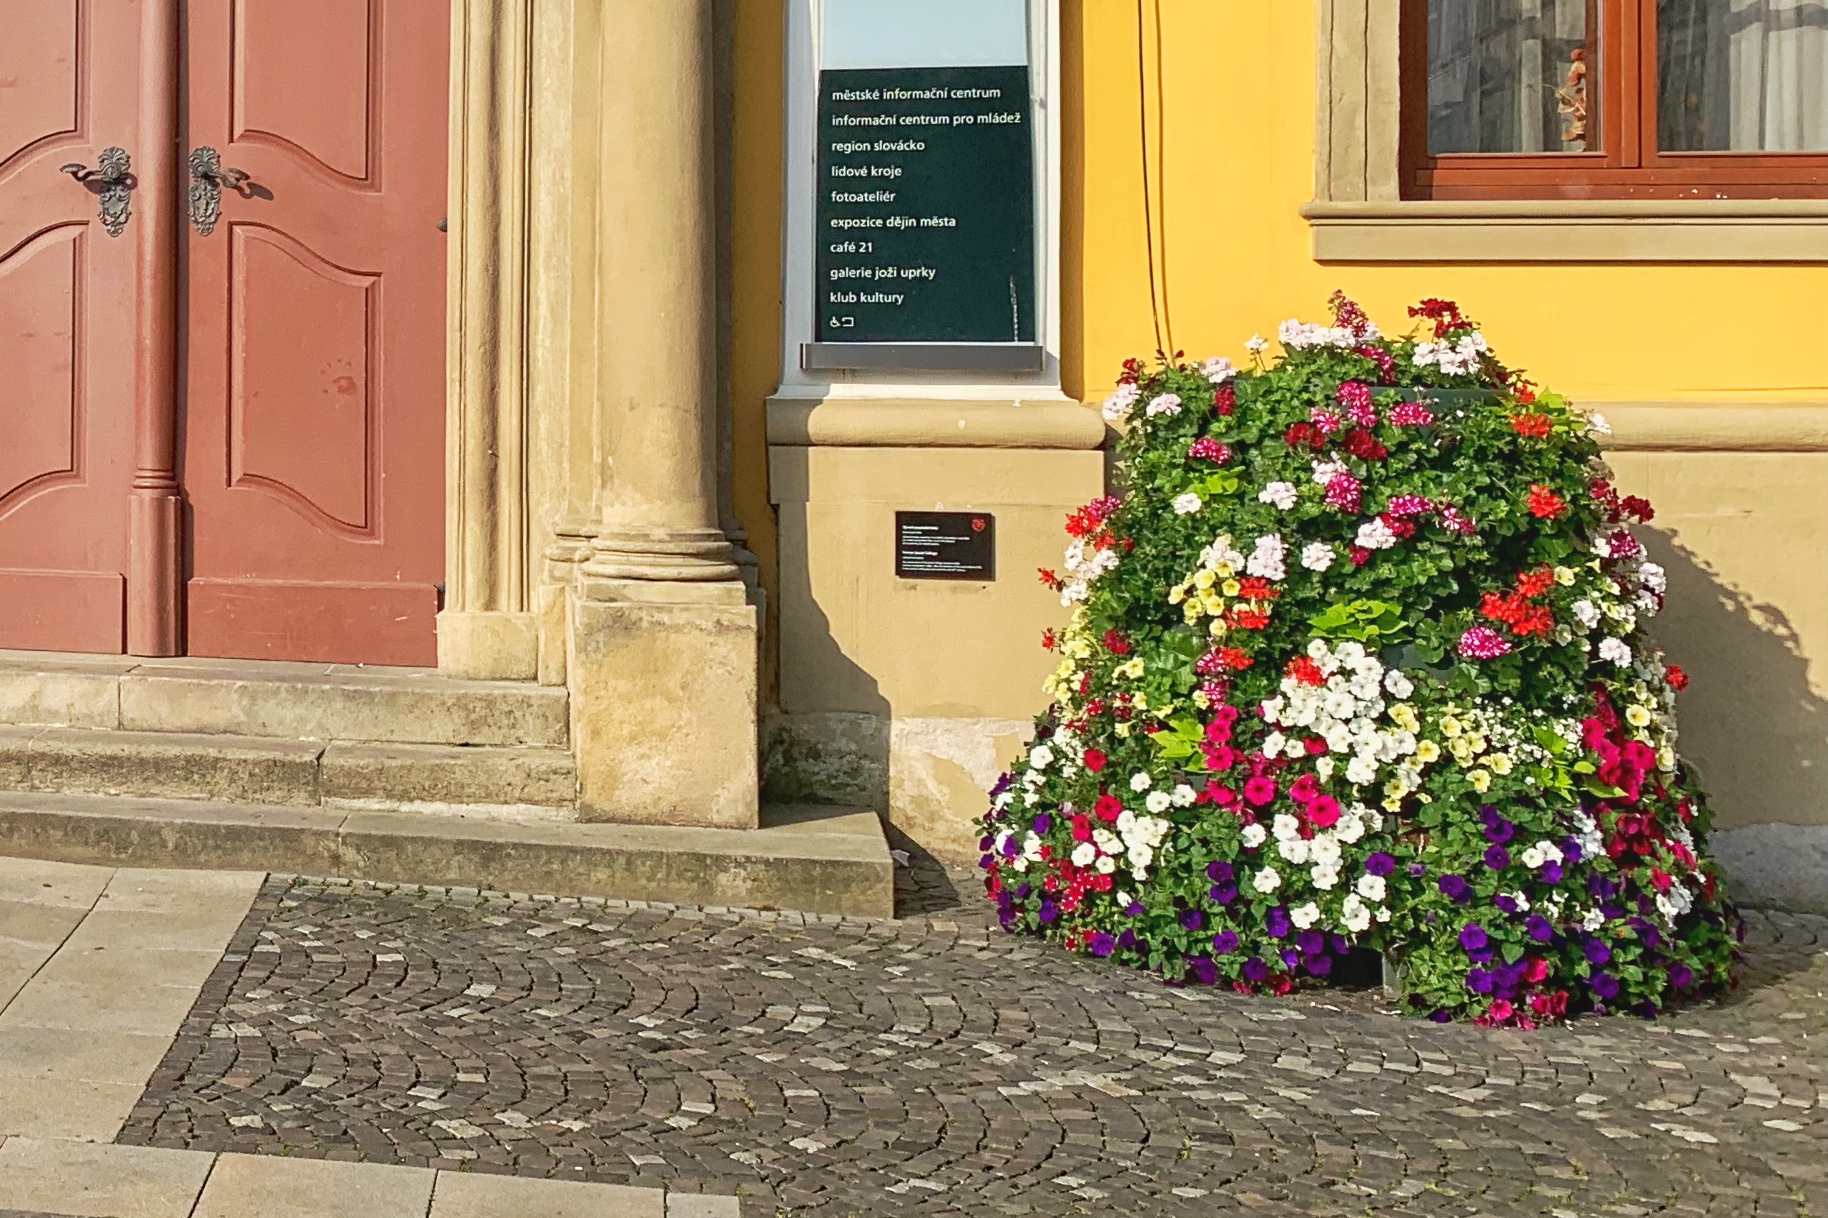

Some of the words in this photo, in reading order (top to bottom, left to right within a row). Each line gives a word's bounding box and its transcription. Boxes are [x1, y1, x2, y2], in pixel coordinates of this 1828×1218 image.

[832, 88, 880, 101] městské
[883, 87, 948, 100] informační
[950, 88, 1001, 99] centrum
[832, 114, 897, 127] informační
[899, 115, 950, 125] centrum
[953, 115, 974, 127] pro
[977, 112, 1021, 124] mládež
[831, 140, 871, 154] region
[873, 140, 925, 152] slovácko
[831, 166, 868, 177] lidové
[871, 165, 902, 179] kroje
[831, 191, 896, 203] fotoateliér
[830, 217, 883, 229] expozice
[886, 216, 917, 230] dějin
[920, 216, 957, 227] města
[830, 242, 856, 253] café
[858, 242, 873, 253] 21
[830, 267, 872, 280] galerie
[874, 267, 898, 280] joži
[900, 267, 936, 280] uprky
[830, 292, 857, 303] klub
[860, 292, 904, 305] kultury
